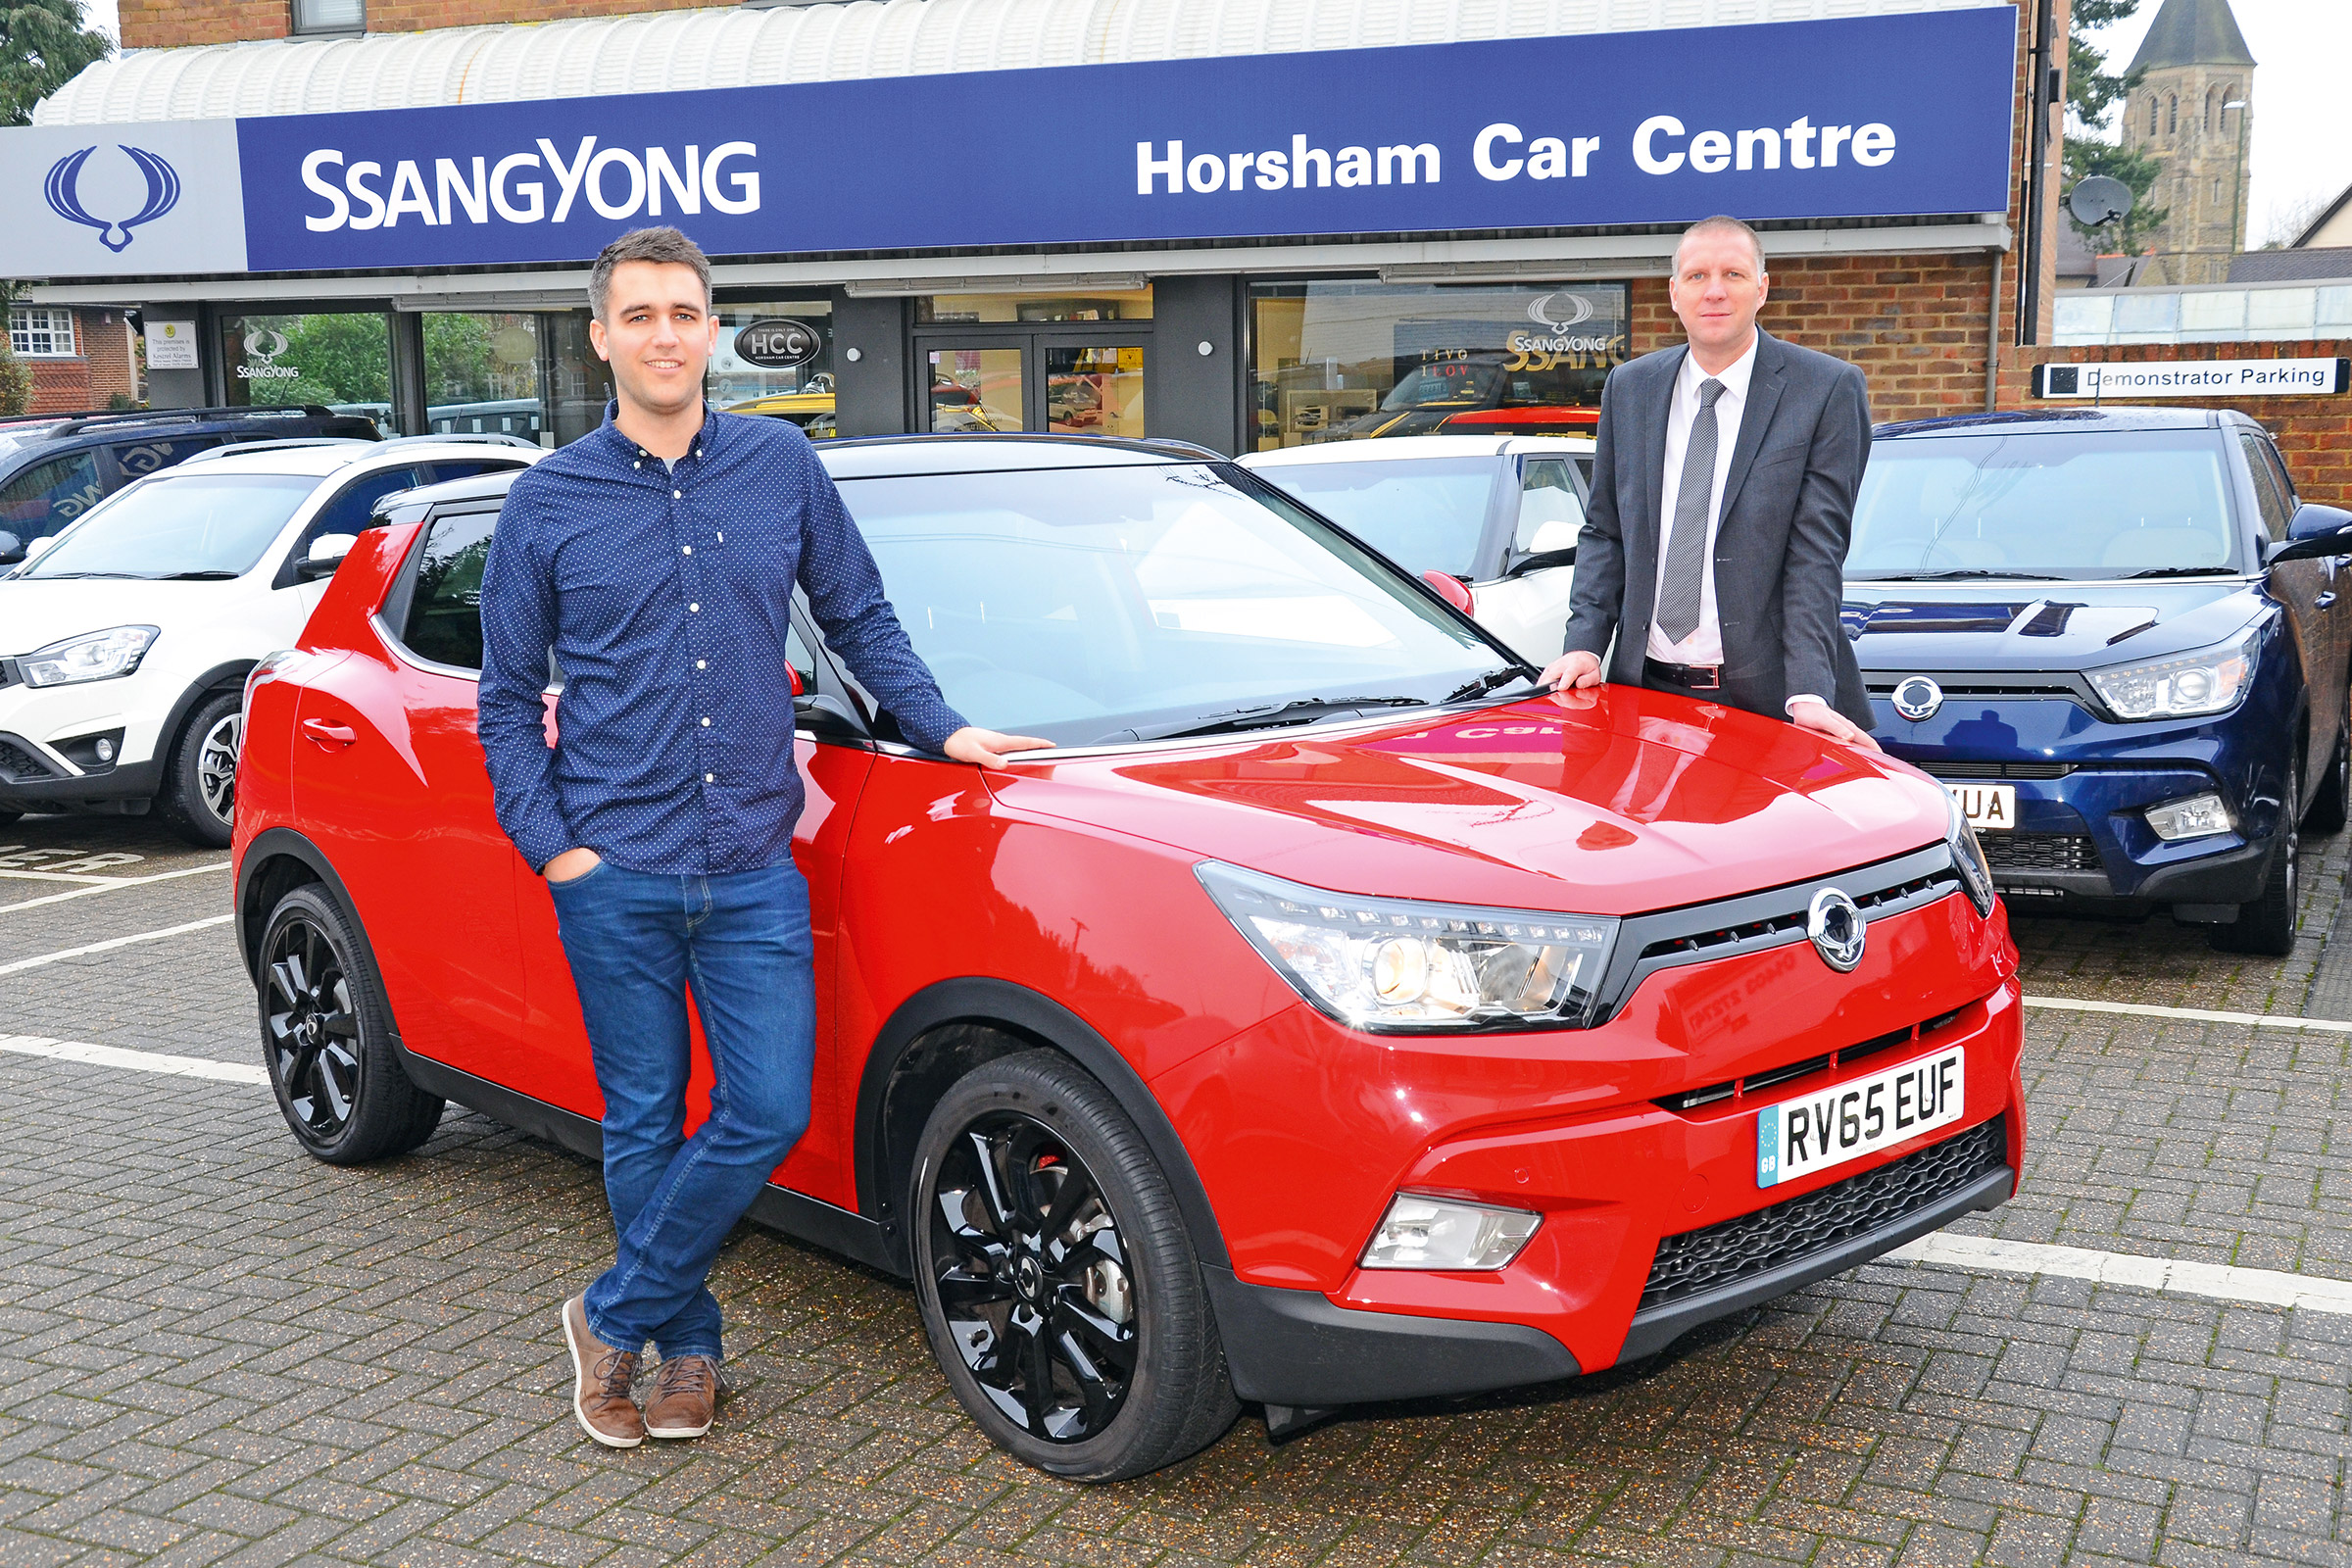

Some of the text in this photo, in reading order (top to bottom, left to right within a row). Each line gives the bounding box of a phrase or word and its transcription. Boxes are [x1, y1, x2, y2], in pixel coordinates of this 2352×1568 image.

[1136, 115, 1897, 195] Horsham Car Centre
[752, 333, 803, 354] HCC
[2087, 368, 2325, 386] Demonstrator Parking
[1952, 789, 2004, 820] UA
[1788, 1056, 1956, 1166] RV65 EUF
[1761, 1154, 1776, 1173] GB
